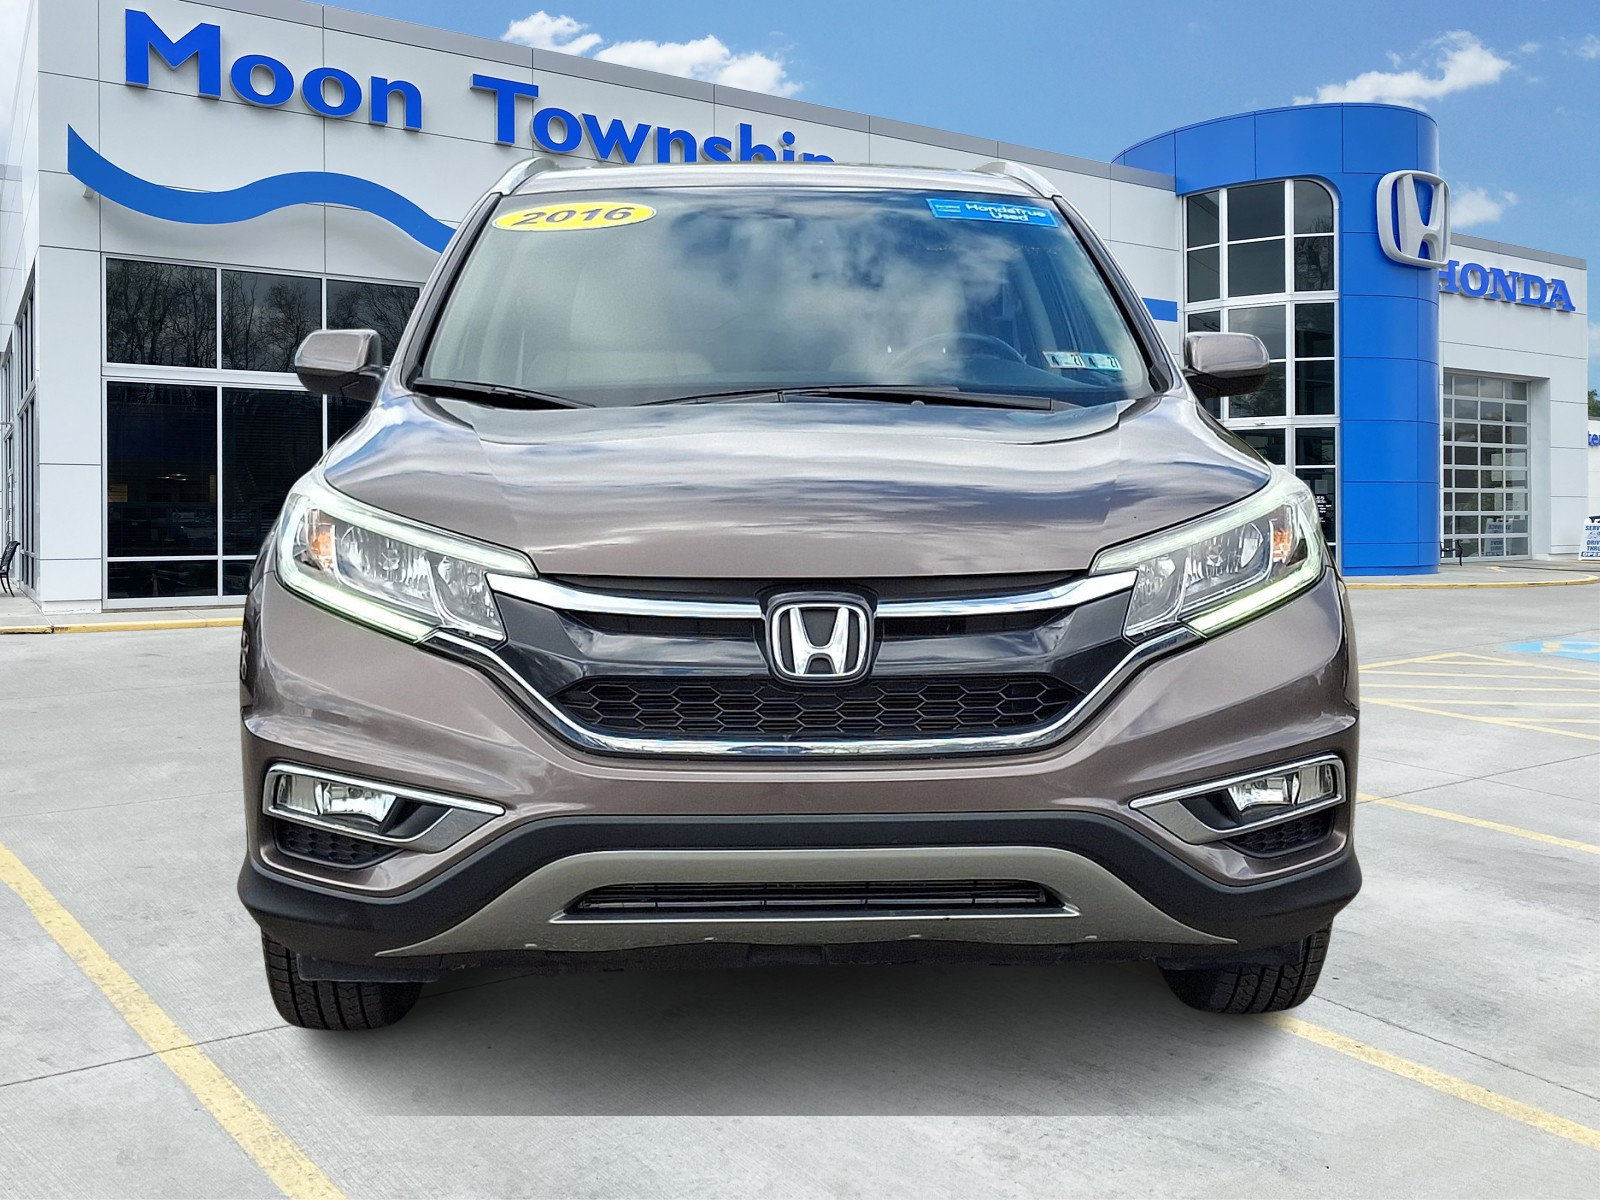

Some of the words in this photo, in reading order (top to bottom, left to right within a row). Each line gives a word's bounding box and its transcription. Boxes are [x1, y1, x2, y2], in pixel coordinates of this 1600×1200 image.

[124, 8, 422, 132] Moon
[470, 73, 836, 164] Townshi
[511, 206, 636, 227] 2016
[989, 209, 1029, 221] Used
